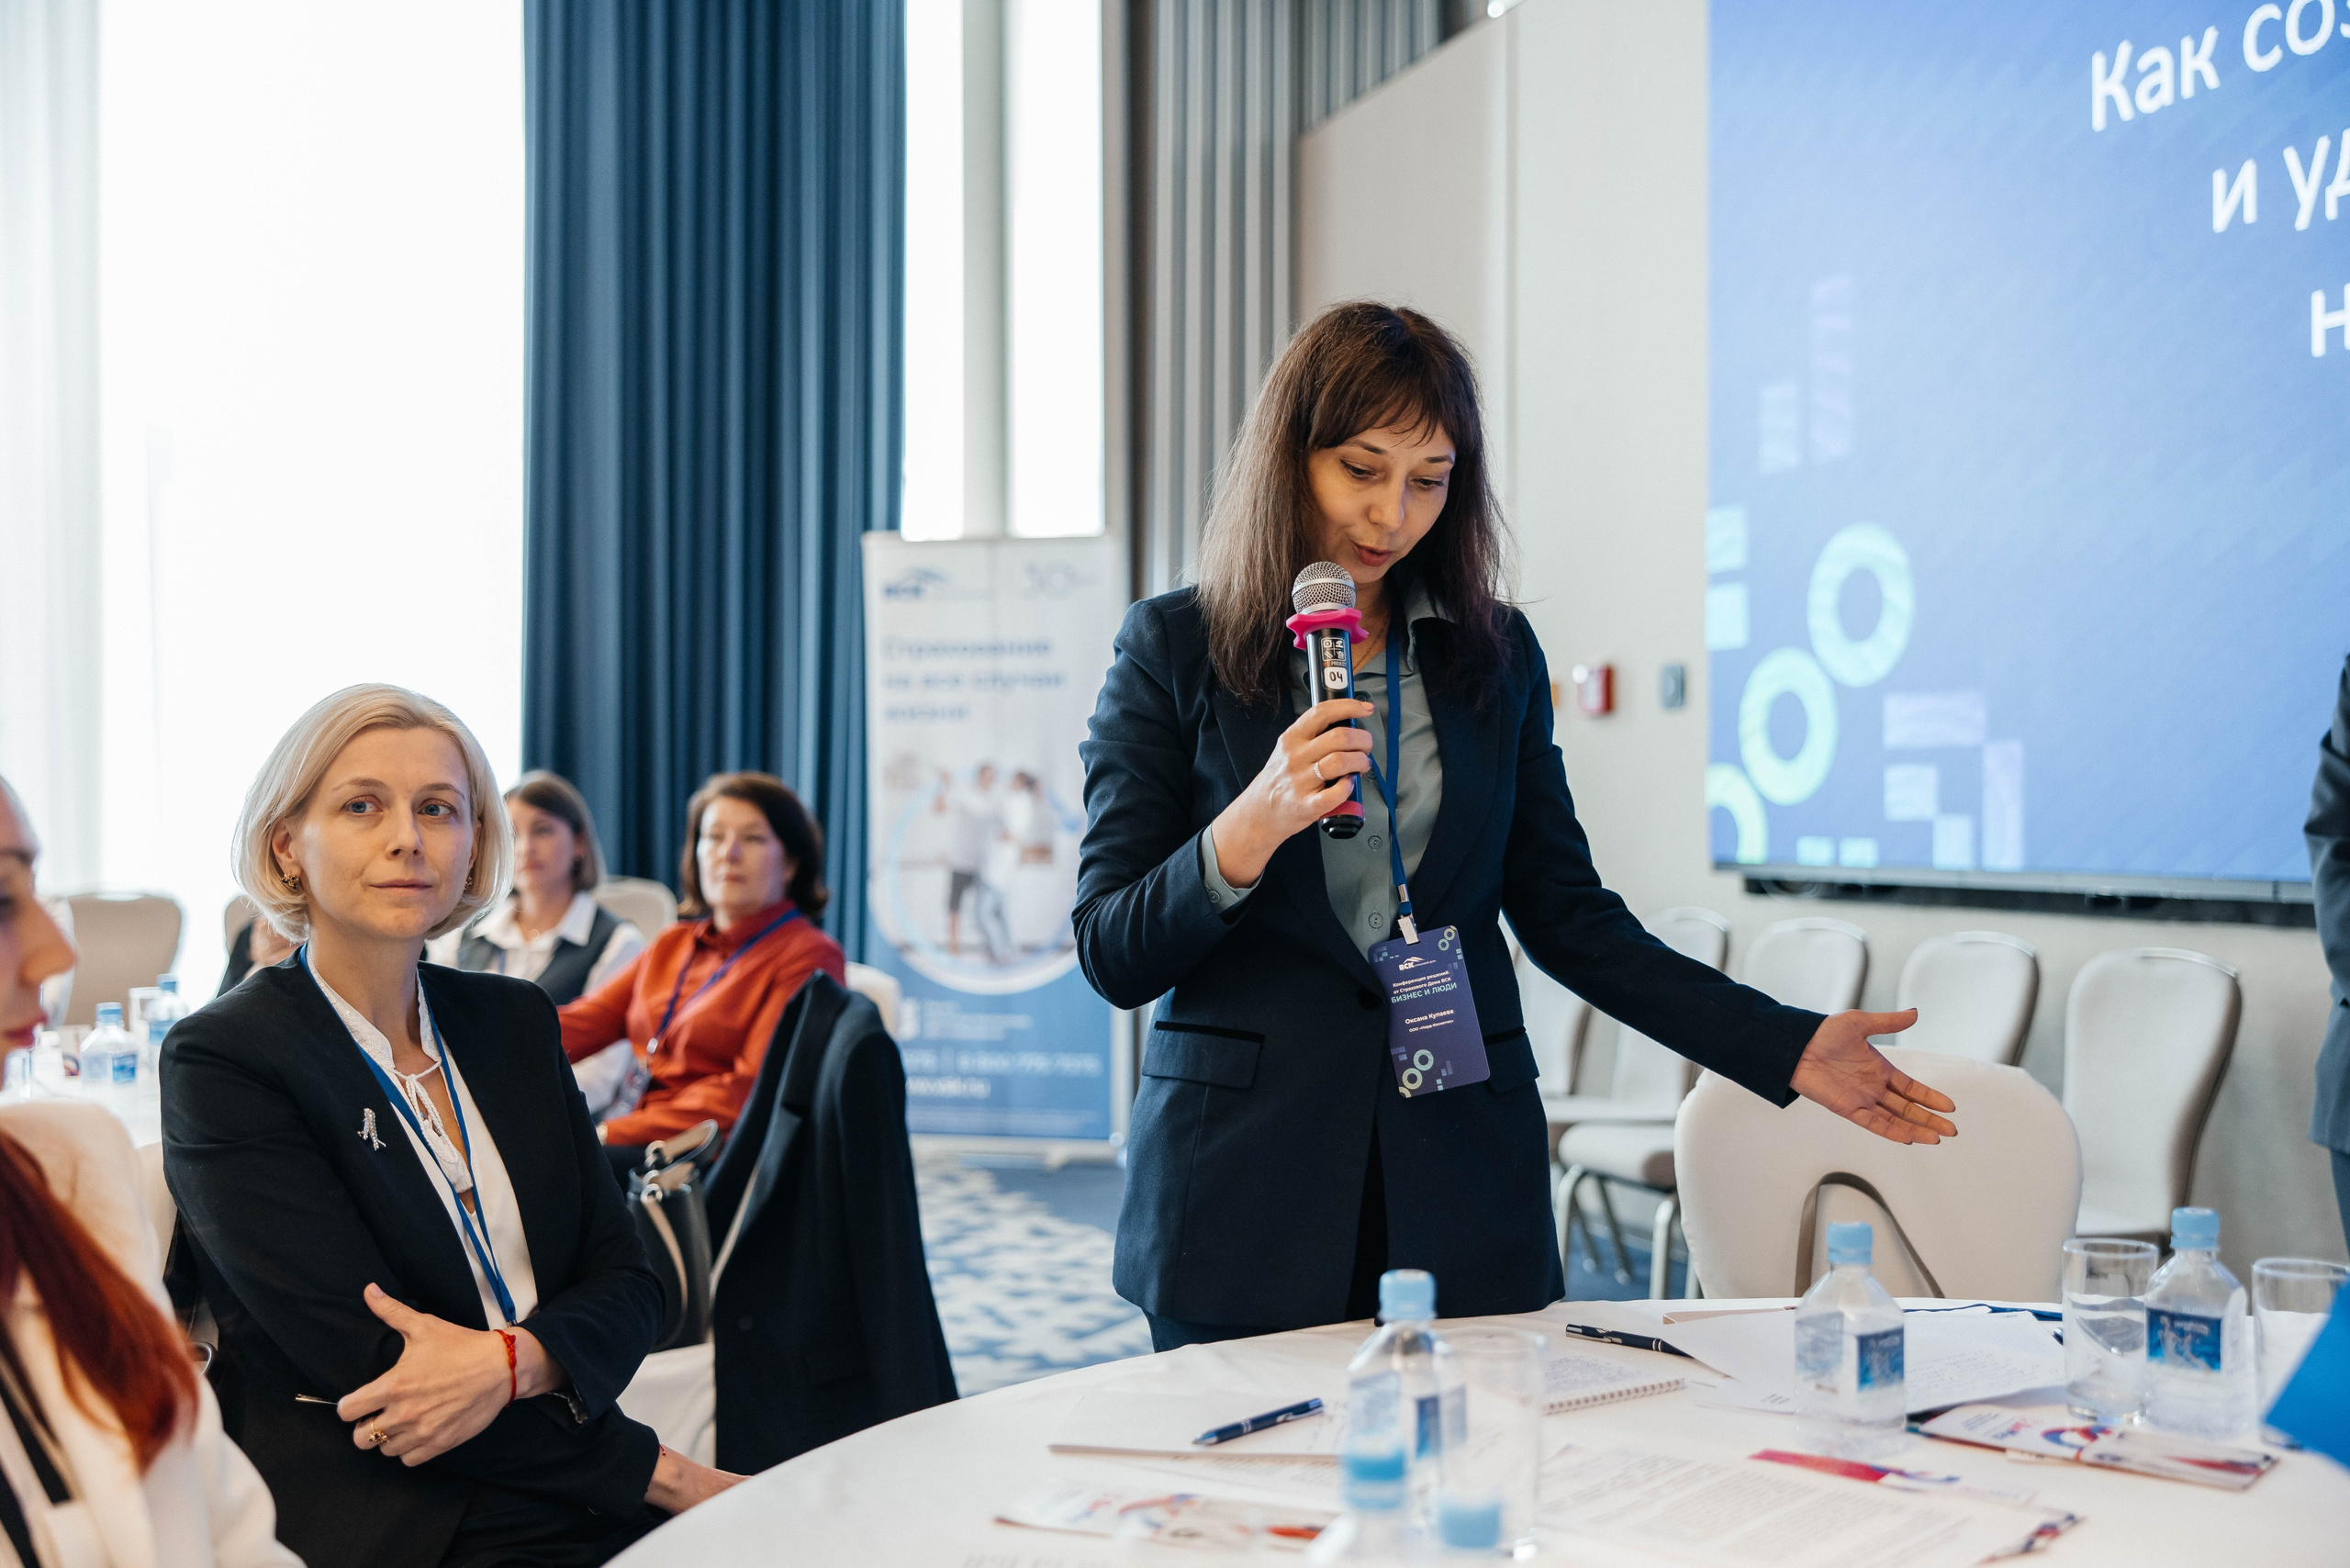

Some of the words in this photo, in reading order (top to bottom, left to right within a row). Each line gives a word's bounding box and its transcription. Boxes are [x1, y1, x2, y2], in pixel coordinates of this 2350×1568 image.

[2091, 26, 2221, 132] Как
[2242, 0, 2350, 73] со
[2211, 159, 2258, 233] и
[1329, 671, 1343, 683] 04
[1399, 962, 1415, 970] ВСК
[1393, 977, 1426, 988] Конференция
[1427, 969, 1449, 980] решений
[1391, 990, 1423, 1003] БИЗНЕС
[1431, 981, 1458, 994] ЛЮДИ
[1399, 983, 1427, 993] Страхового
[1404, 1014, 1428, 1025] Оксана
[1428, 1009, 1454, 1020] Купаева
